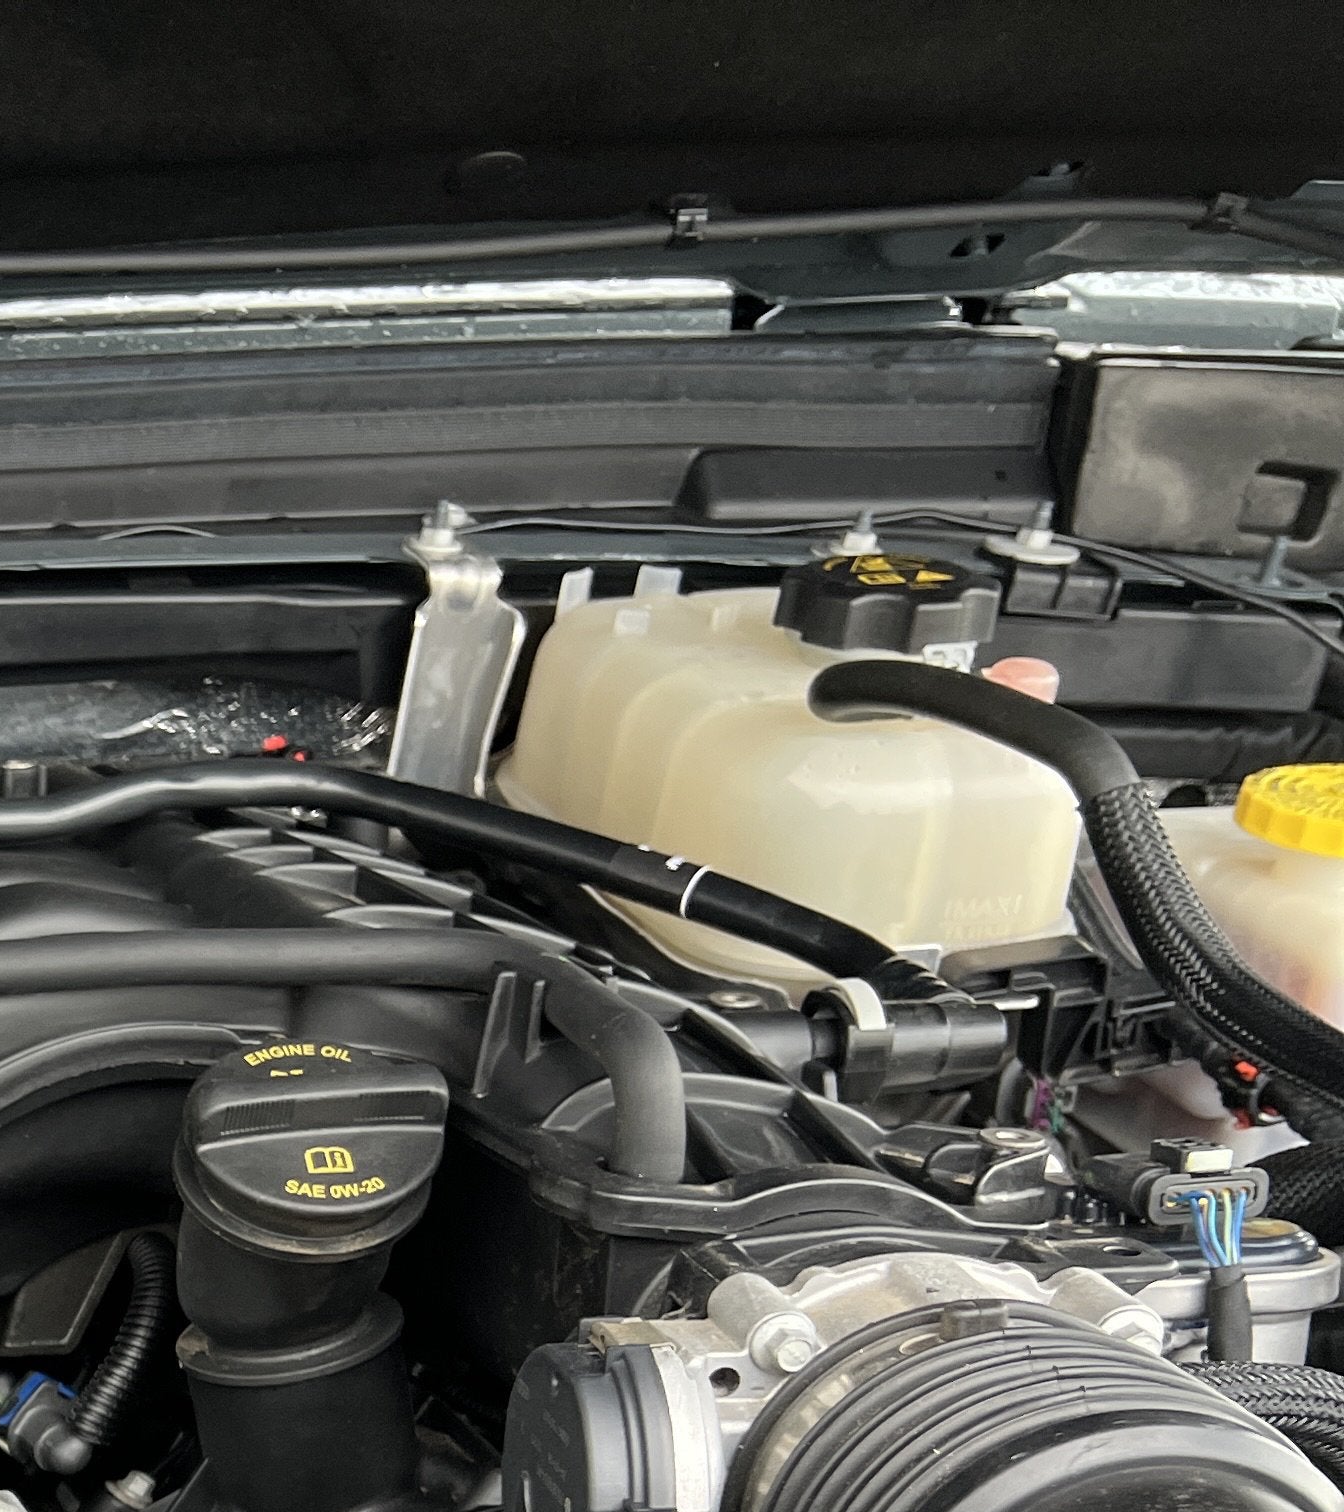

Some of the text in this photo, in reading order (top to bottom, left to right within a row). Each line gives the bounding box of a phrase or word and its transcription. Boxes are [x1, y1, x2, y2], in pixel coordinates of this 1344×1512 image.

[243, 1043, 352, 1067] ENGINE OIL
[285, 1176, 386, 1199] SAE 0W-20
